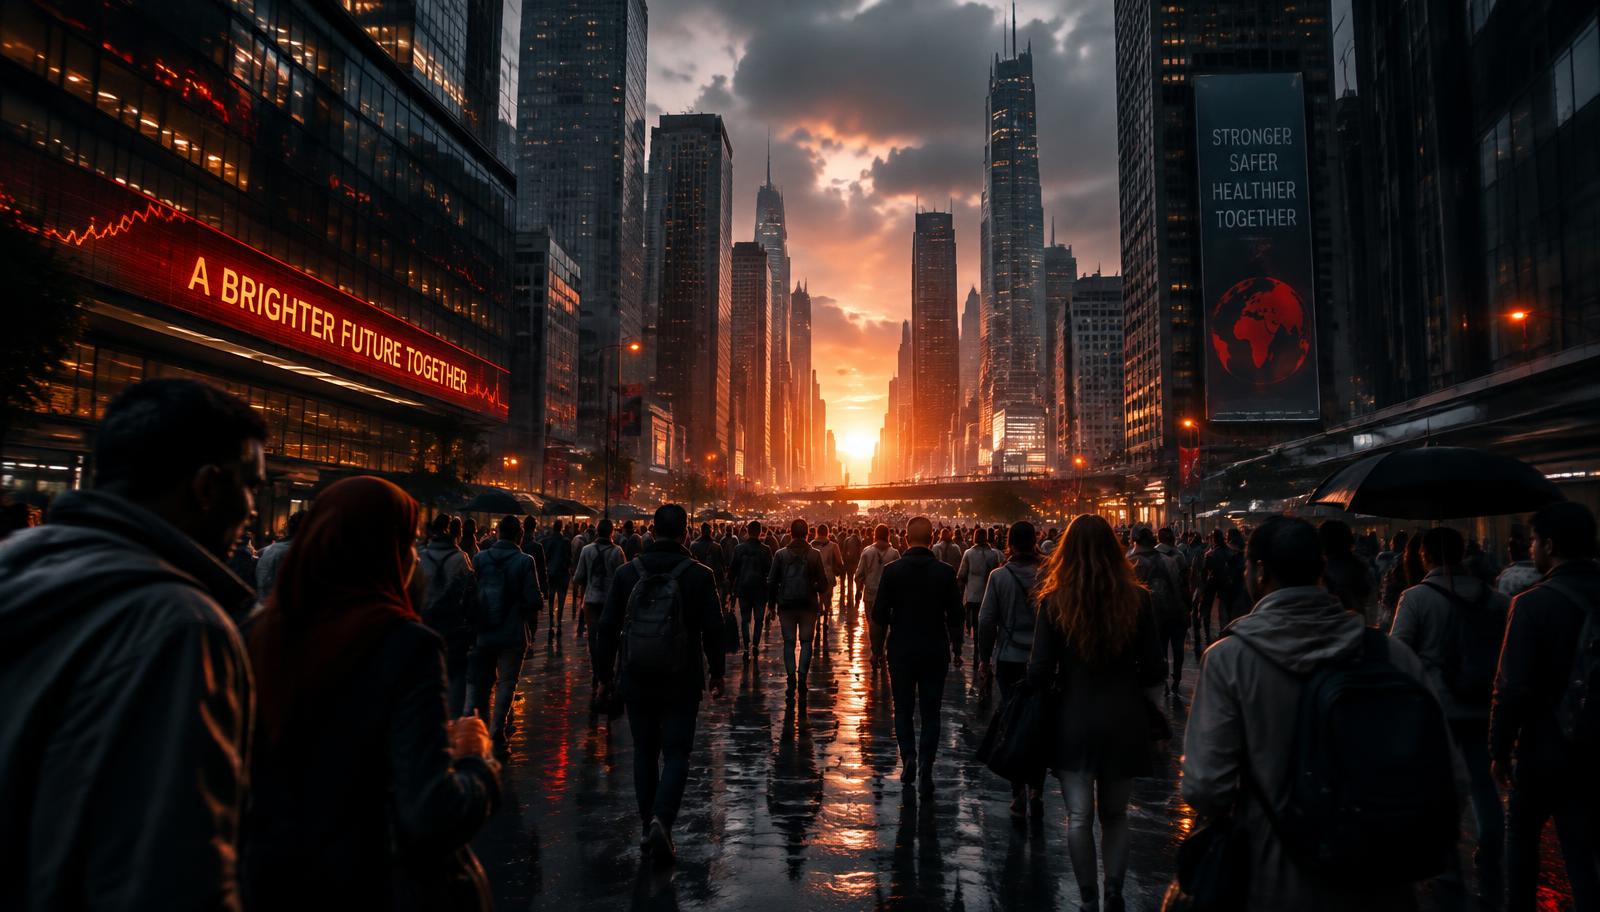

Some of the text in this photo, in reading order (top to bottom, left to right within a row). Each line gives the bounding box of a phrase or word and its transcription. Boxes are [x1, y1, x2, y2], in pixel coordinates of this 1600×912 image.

[1212, 127, 1292, 146] STRONGER
[1230, 152, 1279, 172] SAFER
[1212, 181, 1297, 200] HEALTHIER
[1216, 208, 1297, 229] TOGETHER
[188, 256, 468, 394] A BRIGHTER FUTURE TOGETHER
